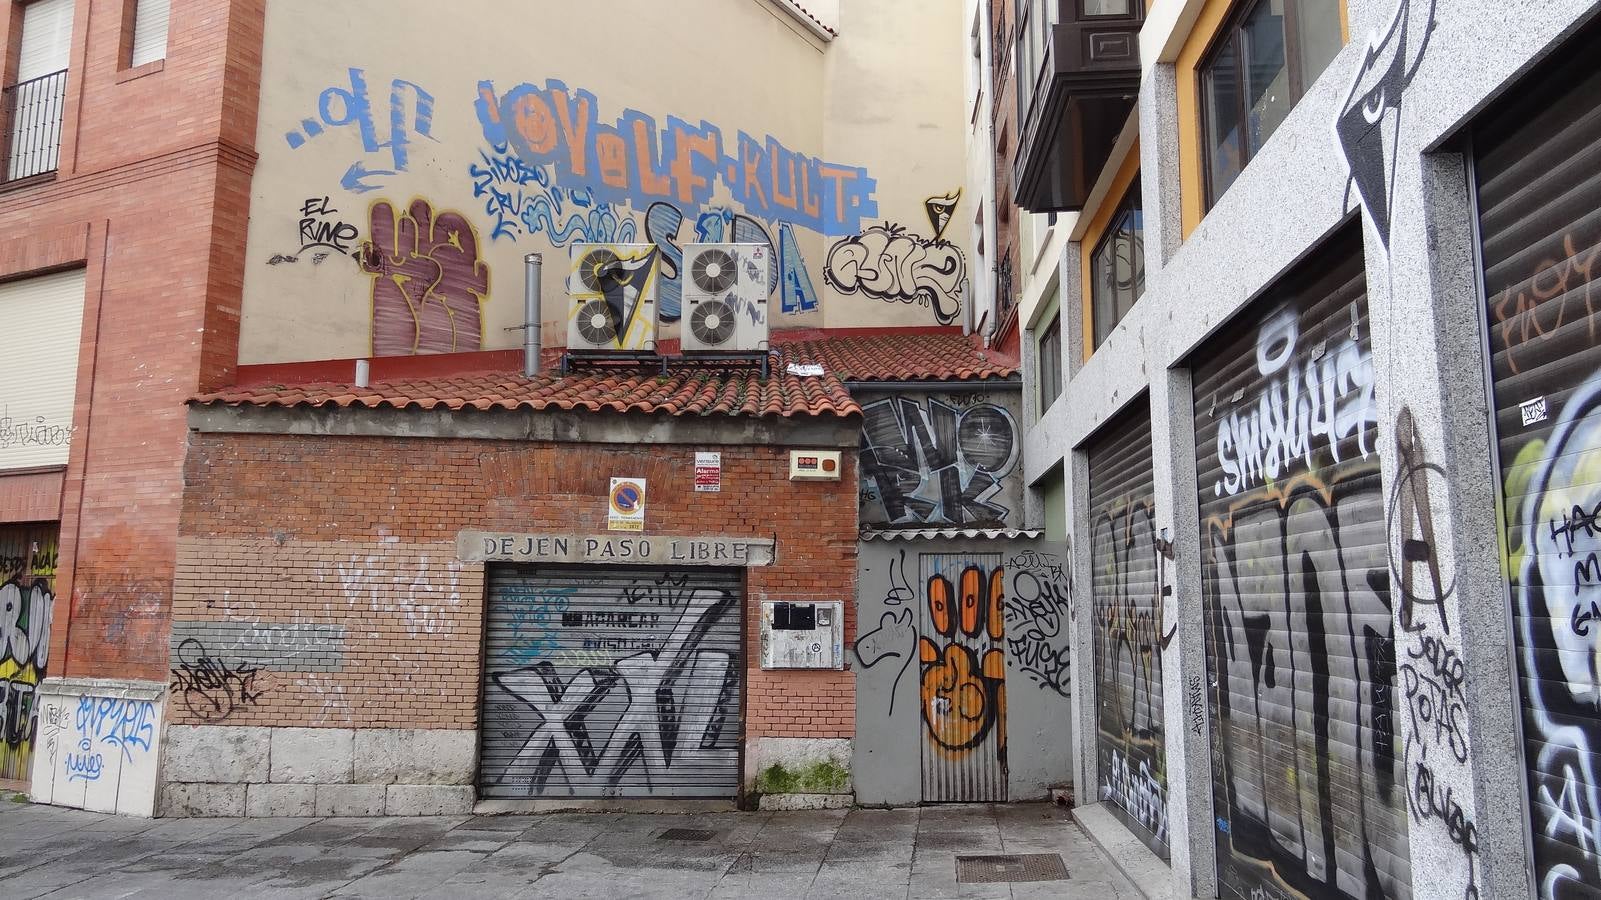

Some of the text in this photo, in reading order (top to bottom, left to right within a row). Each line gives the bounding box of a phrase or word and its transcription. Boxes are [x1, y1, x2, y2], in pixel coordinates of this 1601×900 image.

[299, 196, 338, 215] EL
[484, 537, 747, 561] DEJEN PASO LIBRE
